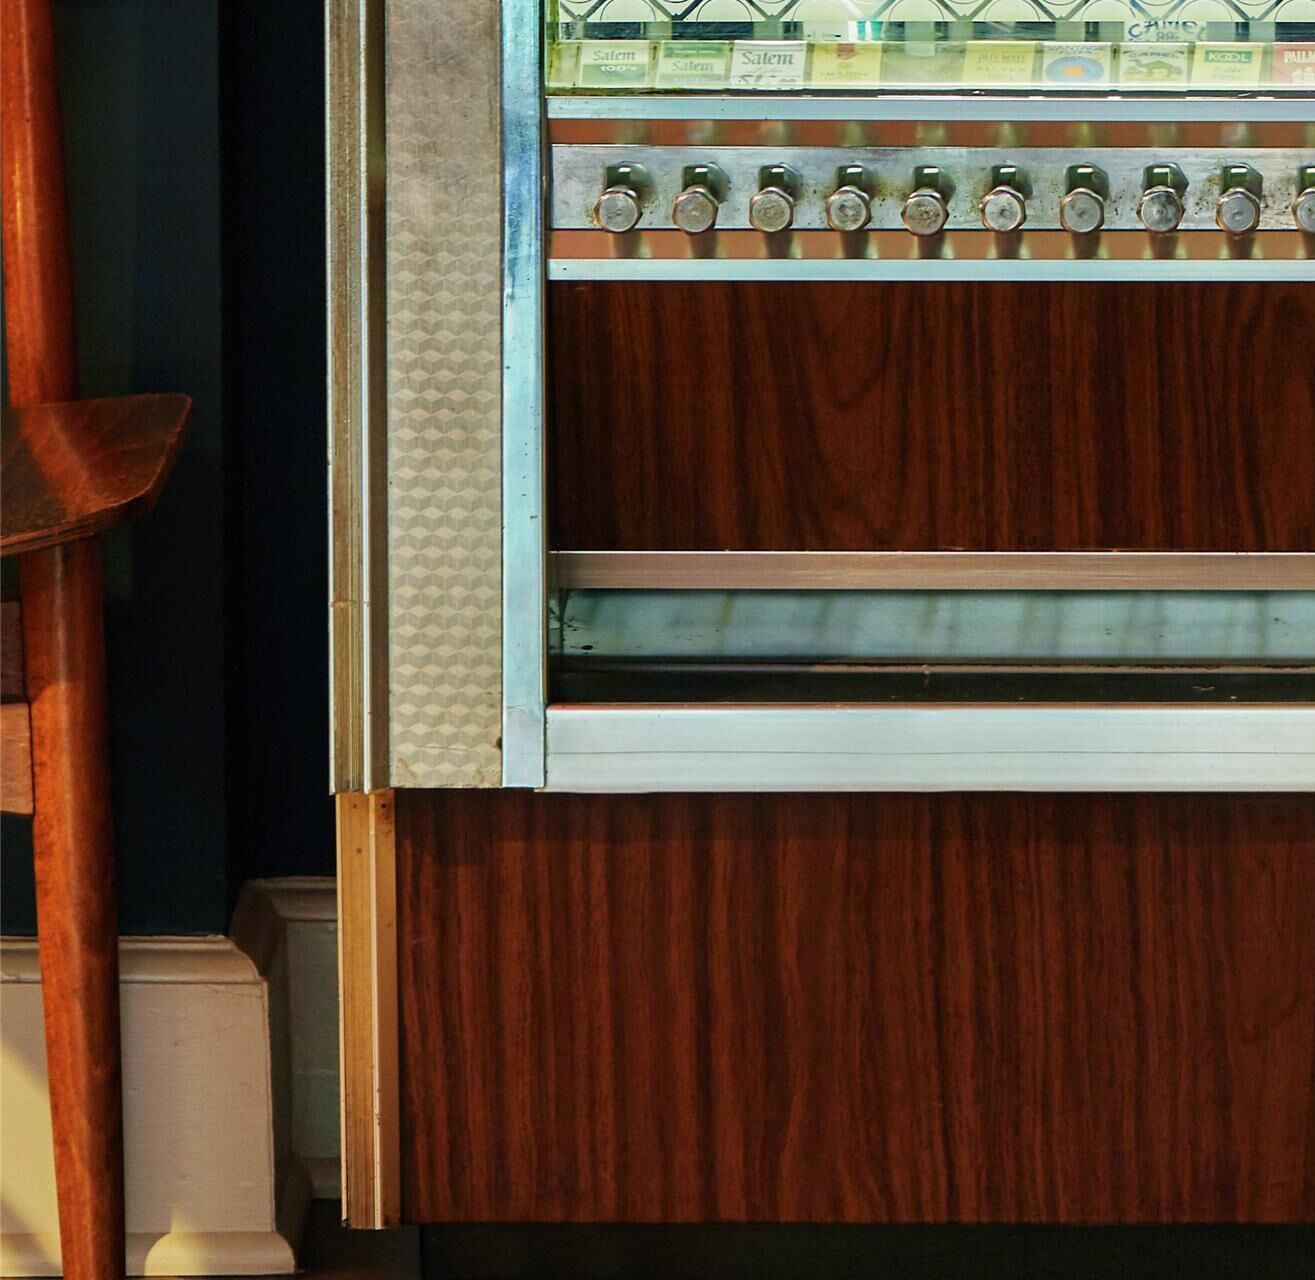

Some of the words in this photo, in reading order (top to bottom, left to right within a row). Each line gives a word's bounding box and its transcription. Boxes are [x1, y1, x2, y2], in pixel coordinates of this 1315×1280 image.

[593, 50, 636, 61] Salem
[741, 51, 794, 65] Salem
[1208, 51, 1249, 62] KOOL
[672, 60, 713, 72] Salem
